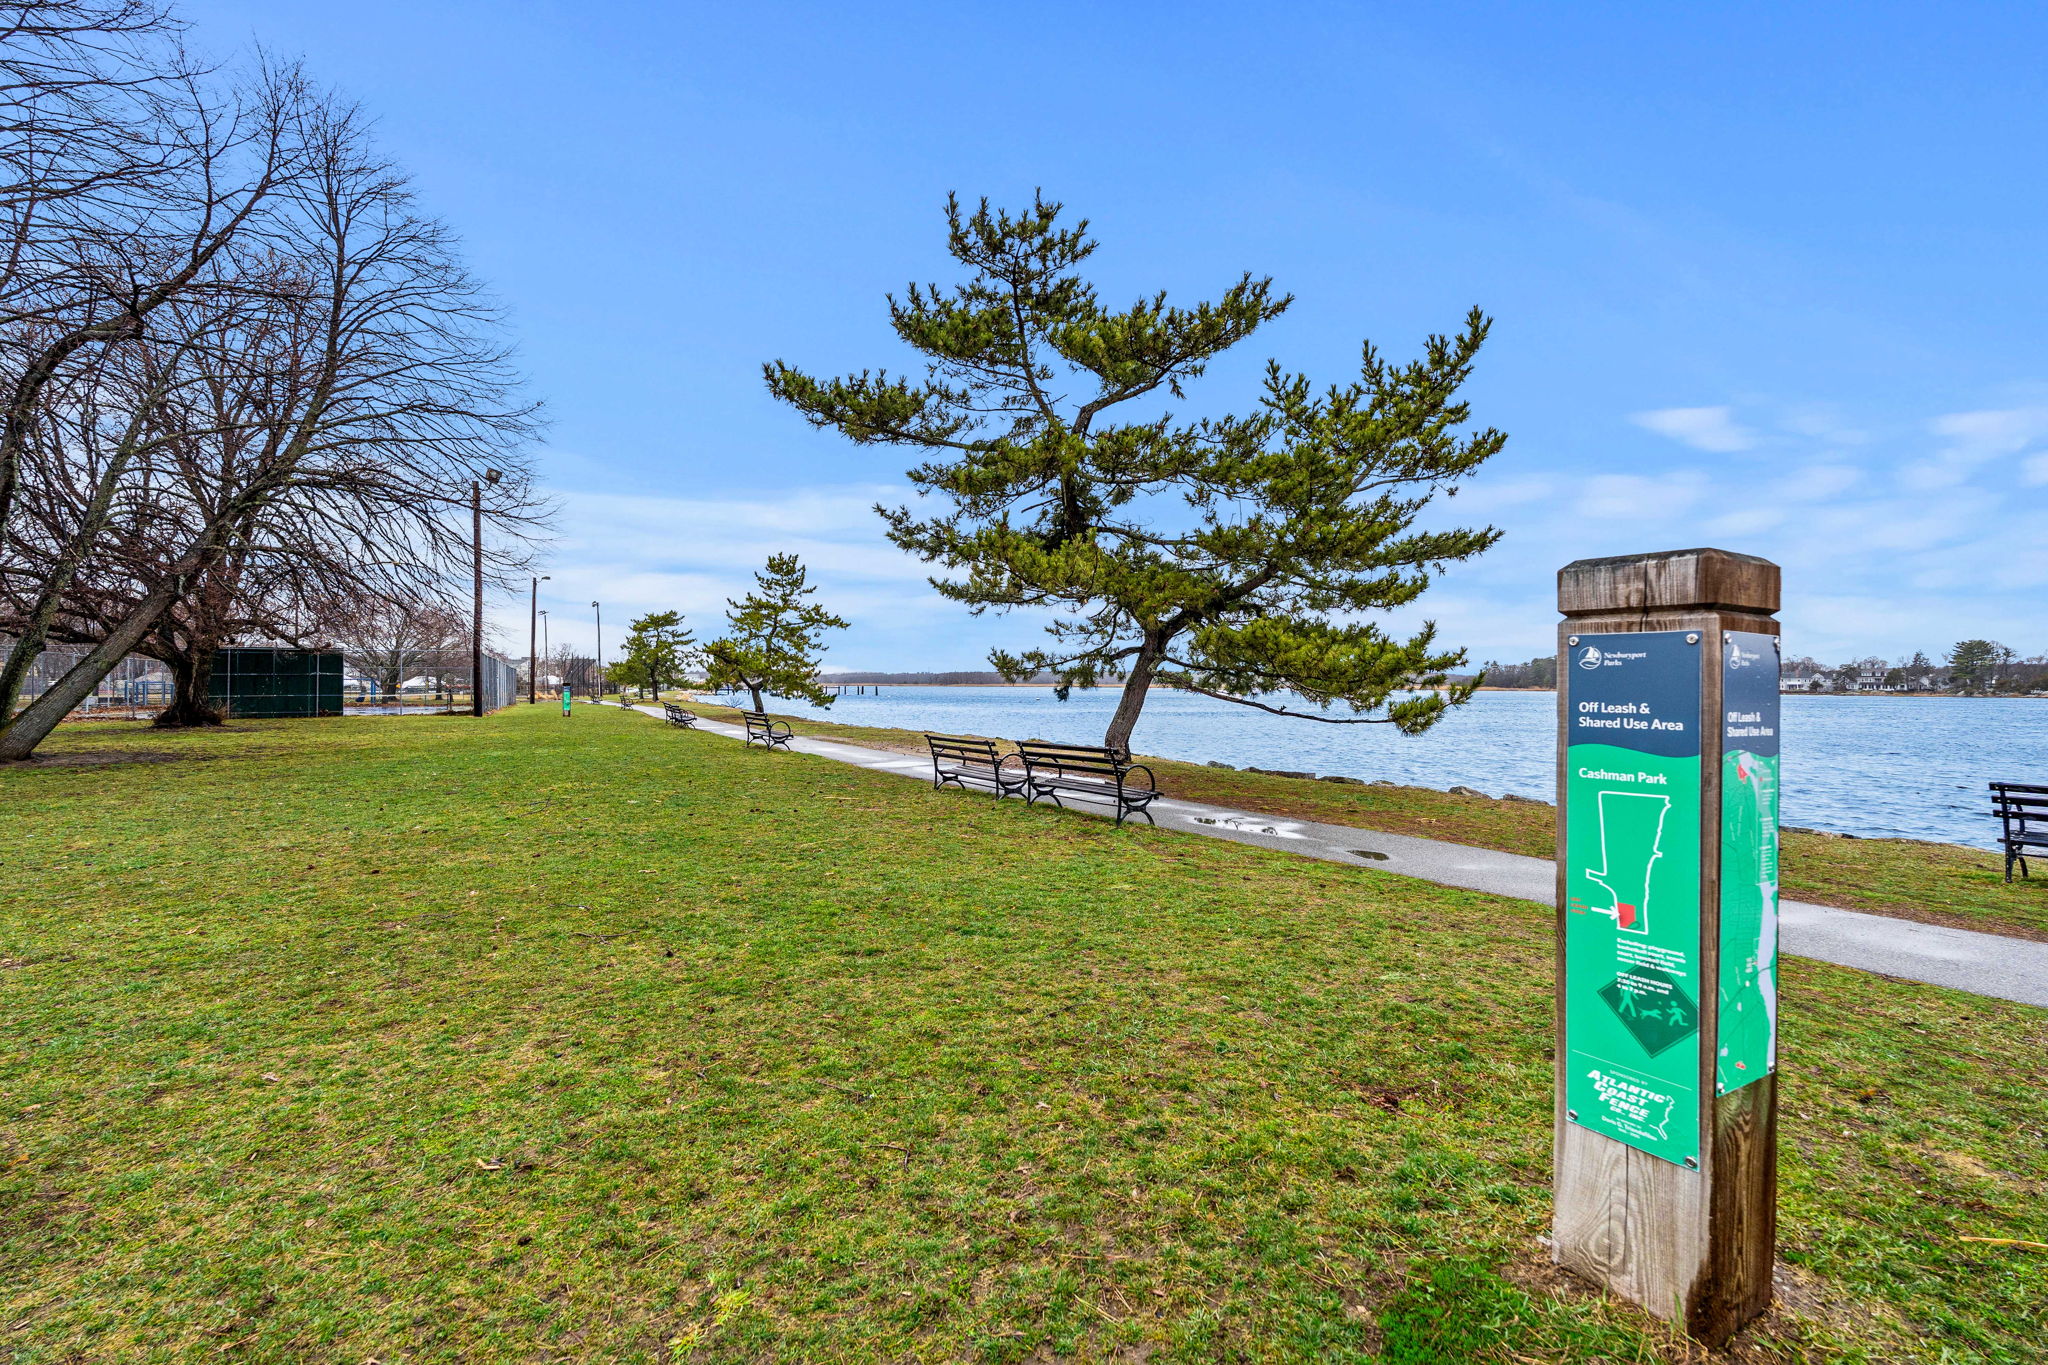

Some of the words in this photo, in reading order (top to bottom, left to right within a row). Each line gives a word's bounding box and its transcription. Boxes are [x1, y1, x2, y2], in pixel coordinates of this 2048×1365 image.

[1579, 702, 1599, 713] Off
[1601, 702, 1637, 714] Leash
[1639, 703, 1650, 714] &
[1579, 716, 1621, 729] Shared
[1623, 717, 1649, 729] Use
[1650, 718, 1684, 731] Area
[1727, 711, 1737, 723] Off
[1737, 711, 1756, 723] Leash
[1727, 726, 1748, 737] Shared
[1760, 725, 1774, 737] Area
[1579, 767, 1635, 782] Cashman
[1637, 771, 1667, 785] Park
[1587, 1070, 1666, 1103] ATLANTIC
[1593, 1081, 1649, 1107] COAST
[1598, 1091, 1650, 1118] FENCE
